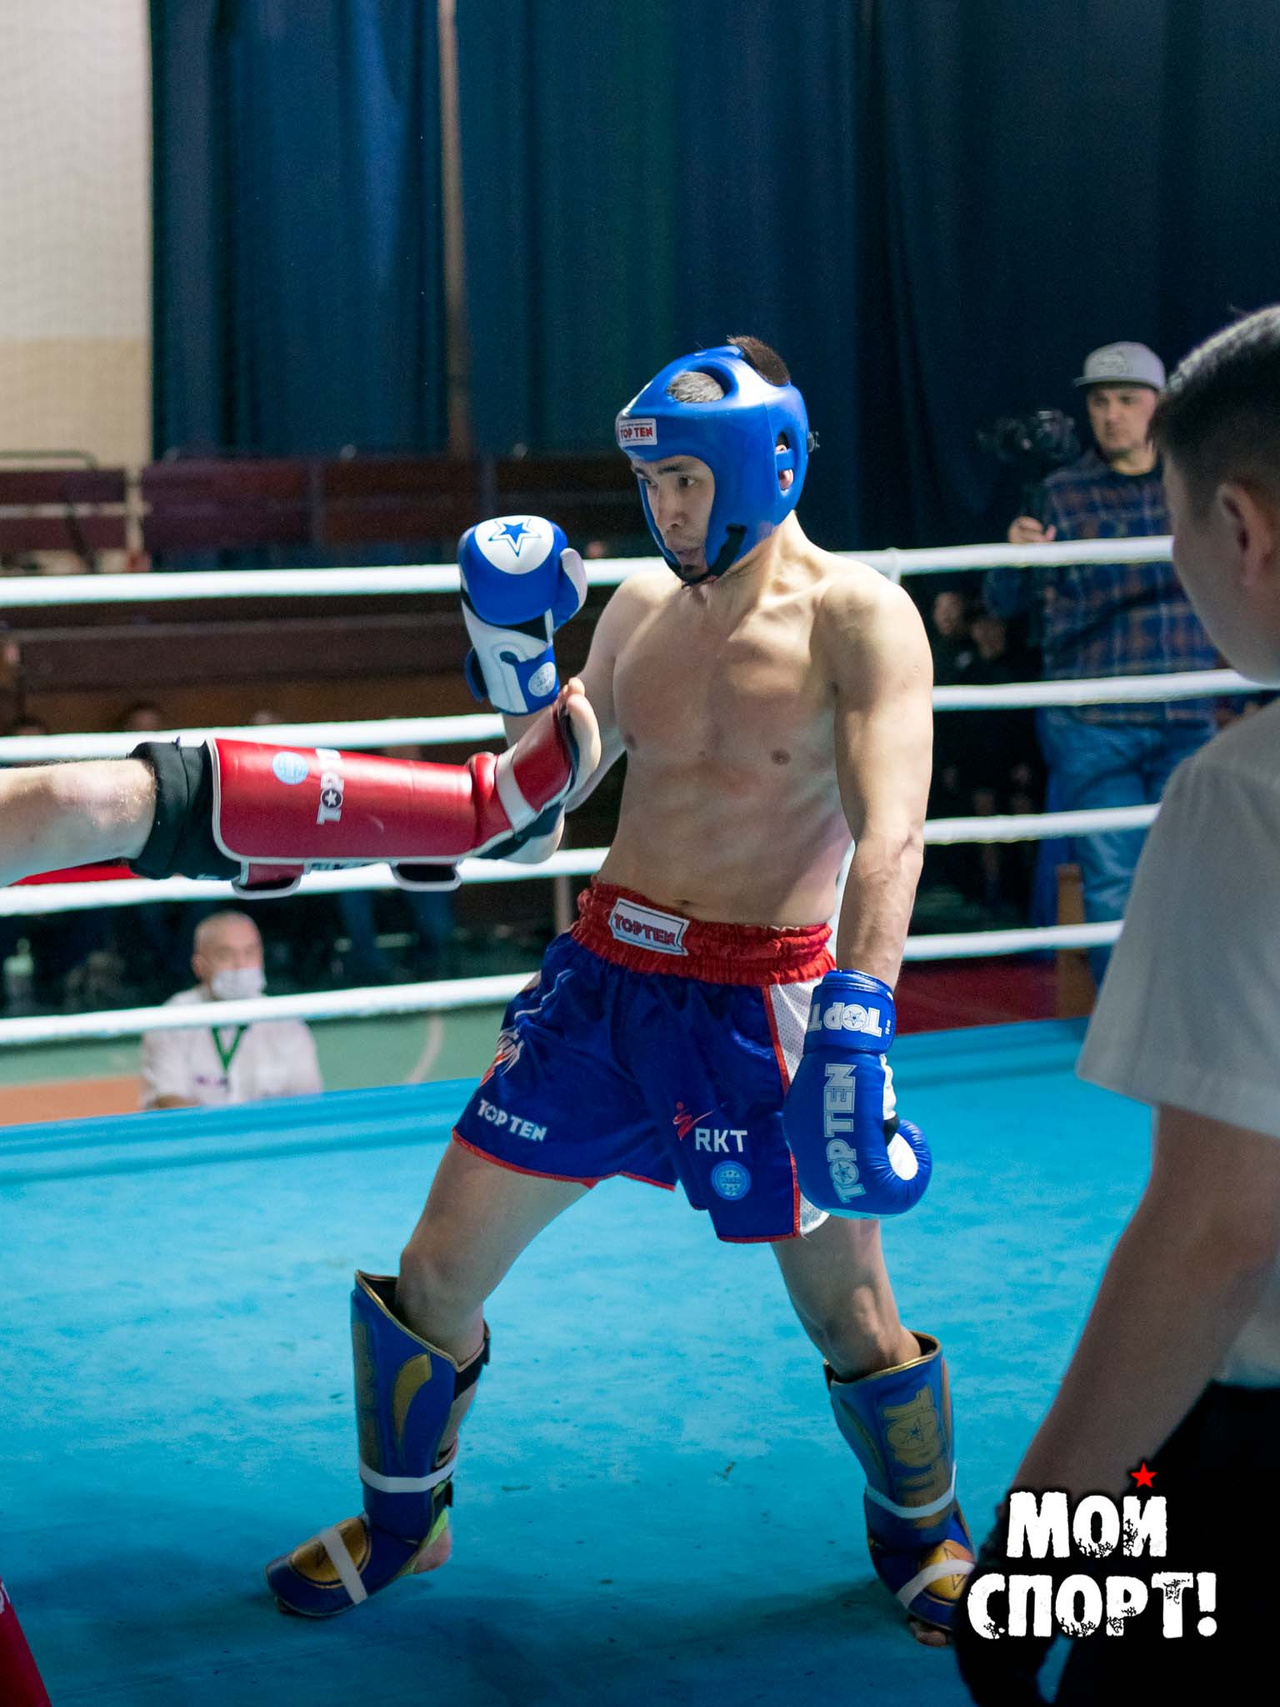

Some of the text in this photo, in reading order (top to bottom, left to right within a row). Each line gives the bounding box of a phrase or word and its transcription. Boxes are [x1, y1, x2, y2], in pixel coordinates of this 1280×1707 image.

[634, 426, 653, 438] TEN
[316, 771, 344, 825] TOP
[823, 1002, 883, 1038] TOP
[477, 1098, 548, 1142] TOP TEN
[695, 1127, 748, 1153] RKT
[824, 1063, 867, 1204] TOP TEN
